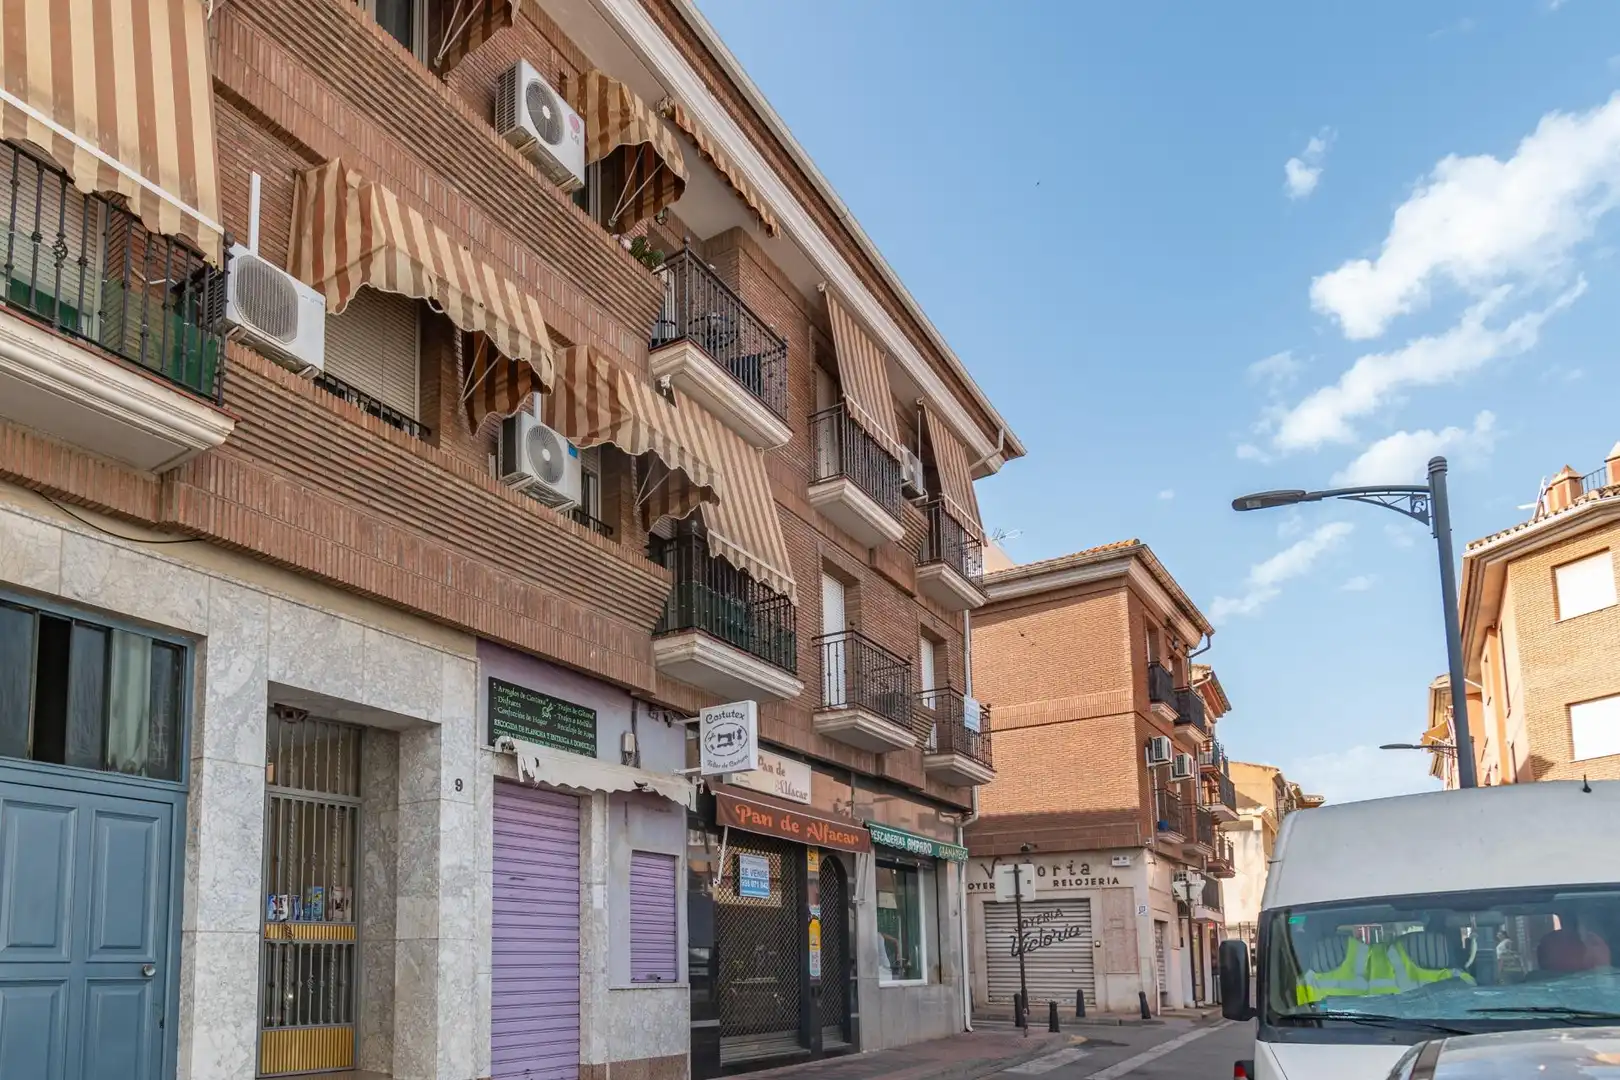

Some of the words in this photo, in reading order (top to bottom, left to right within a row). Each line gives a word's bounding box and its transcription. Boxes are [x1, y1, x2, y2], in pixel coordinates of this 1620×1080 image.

[498, 695, 521, 708] Disfraces
[494, 718, 518, 730] RECOGIDA
[705, 709, 745, 724] Costutex
[707, 759, 721, 769] Taller
[729, 754, 749, 768] Costura
[775, 761, 785, 778] de
[455, 778, 463, 792] 9
[735, 804, 773, 826] Pan
[780, 815, 800, 833] de
[806, 821, 859, 845] Alfacar
[906, 838, 932, 855] AMPARO
[741, 867, 749, 877] SE
[749, 869, 768, 880] VENDE
[980, 856, 1091, 880] Voria
[1052, 877, 1119, 887] RELOJERIA
[1021, 908, 1064, 929] OYERIA
[1009, 923, 1082, 957] Victoria
